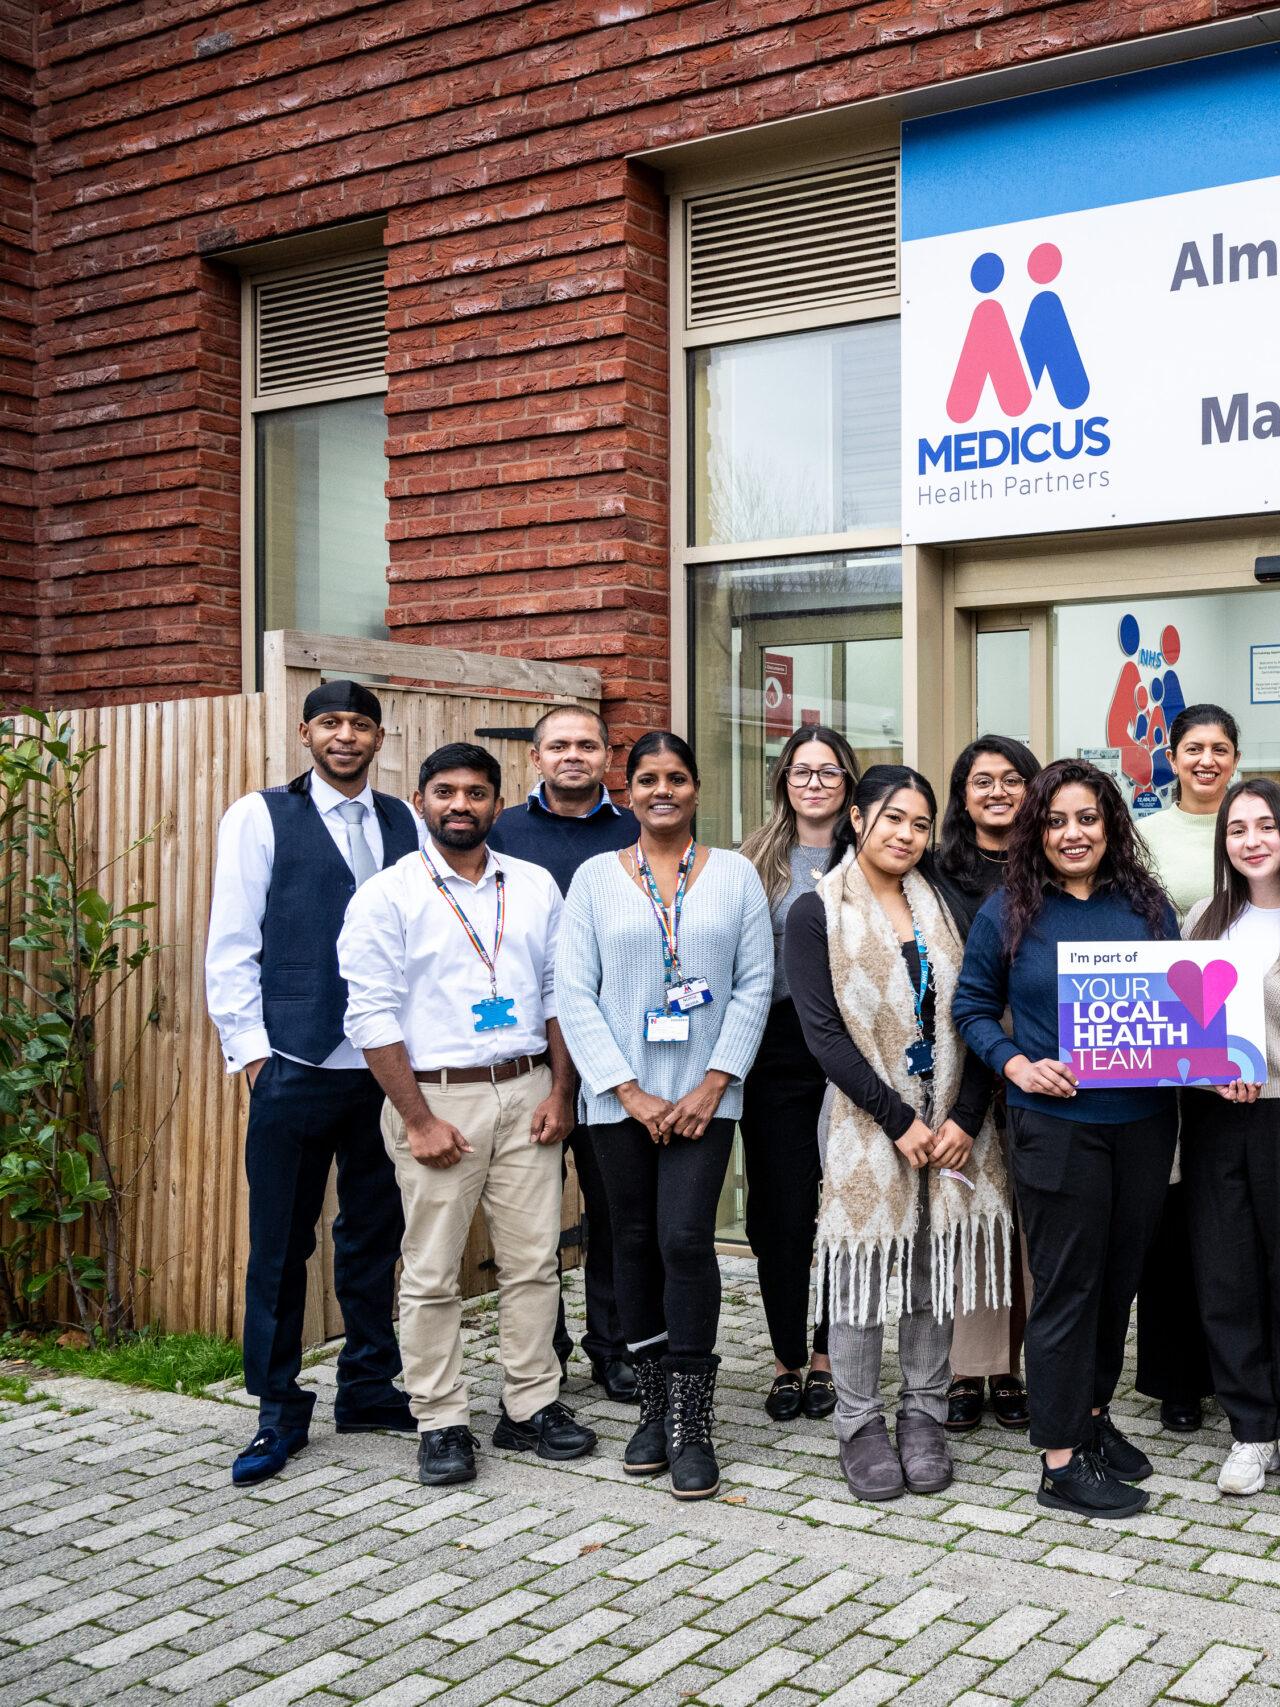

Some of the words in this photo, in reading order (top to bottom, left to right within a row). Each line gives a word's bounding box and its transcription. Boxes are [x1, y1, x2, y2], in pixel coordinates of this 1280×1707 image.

[918, 416, 1111, 476] MEDICUS
[918, 478, 993, 506] Health
[1004, 470, 1110, 496] Partners
[1140, 648, 1163, 669] NHS
[1070, 953, 1089, 963] I'm
[1093, 953, 1122, 966] part
[1124, 951, 1138, 963] of
[1071, 978, 1150, 1000] YOUR
[1072, 1001, 1168, 1023] LOCAL
[1072, 1023, 1188, 1047] HEALTH
[1072, 1047, 1153, 1071] TEAM
